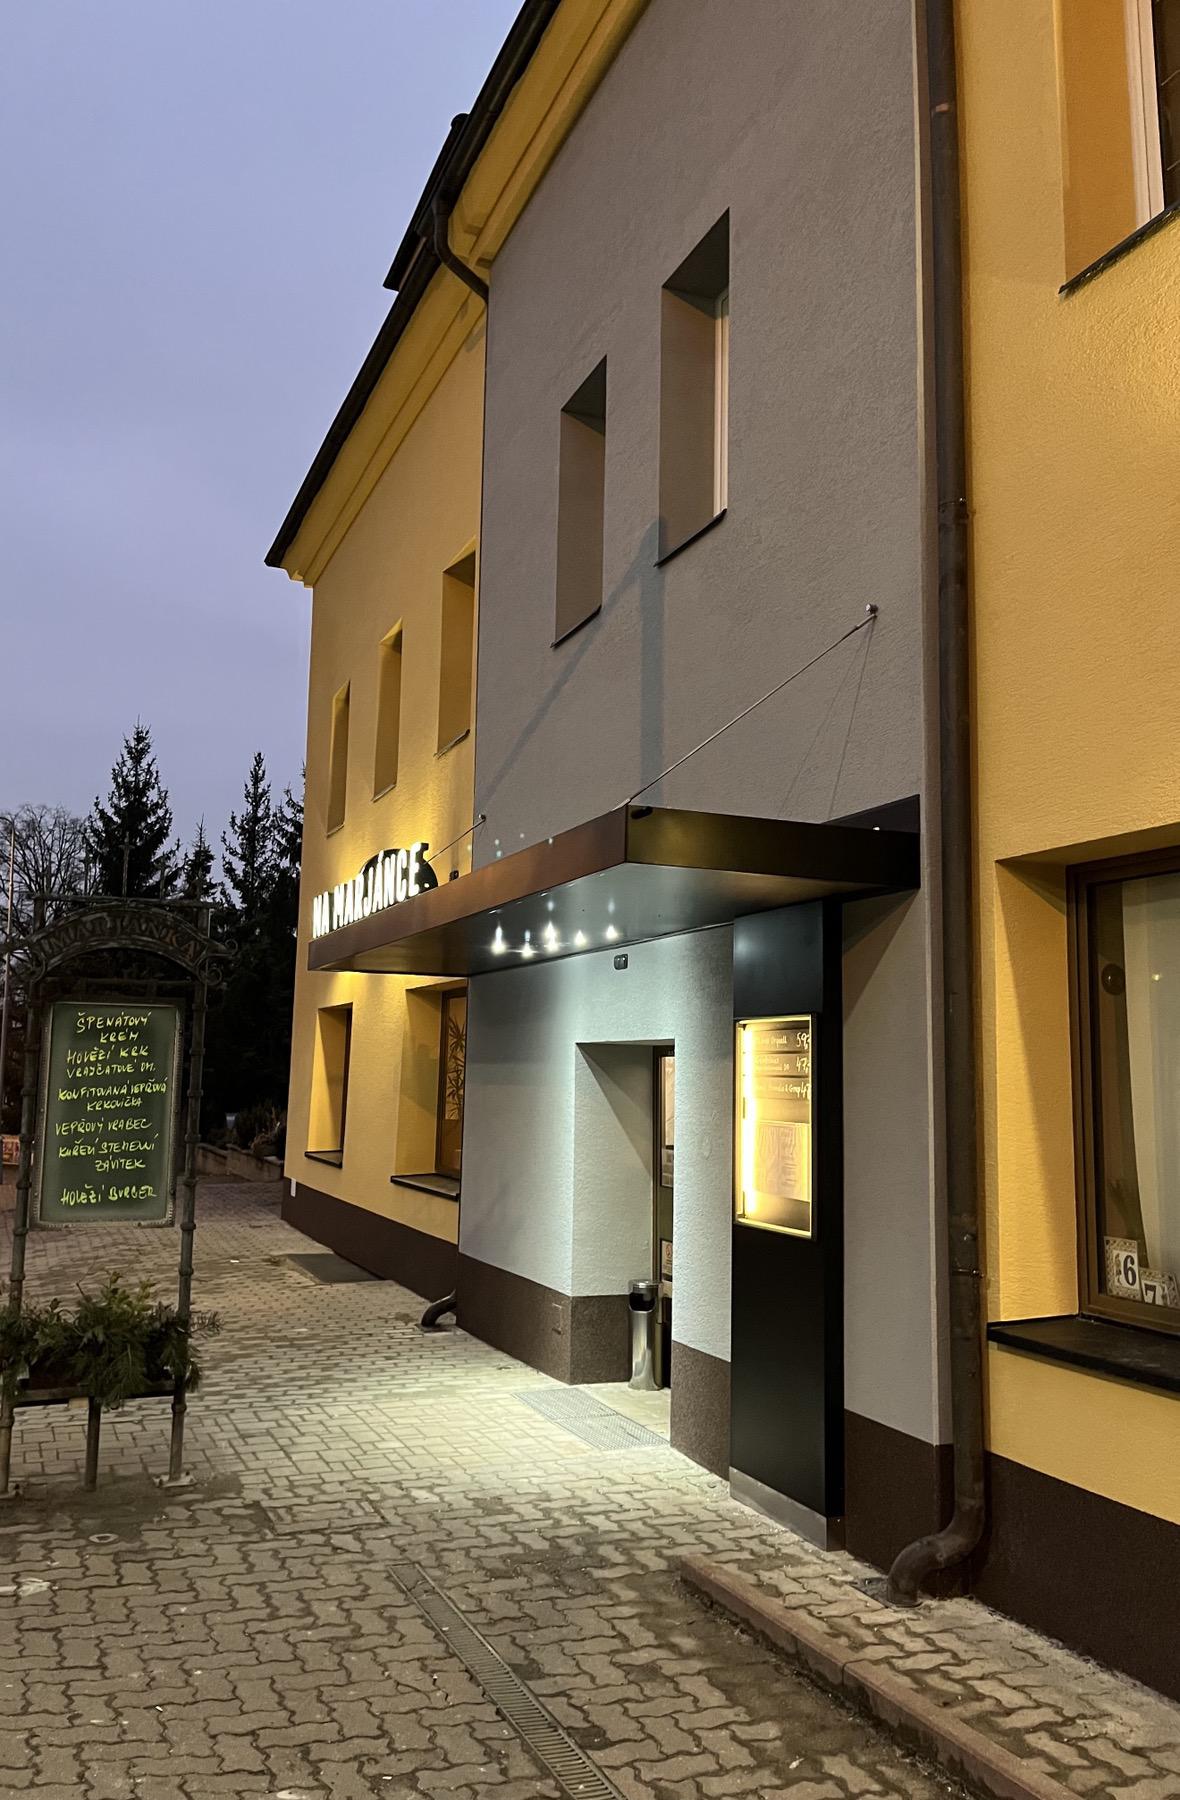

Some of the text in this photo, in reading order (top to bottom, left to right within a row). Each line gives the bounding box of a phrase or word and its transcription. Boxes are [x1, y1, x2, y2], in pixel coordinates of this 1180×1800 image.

[312, 891, 330, 939] NA
[76, 1011, 152, 1033] ŠPENÁTOVÝ
[119, 1045, 149, 1058] KRK
[107, 1118, 153, 1132] VRABEC
[1122, 1254, 1137, 1287] 6
